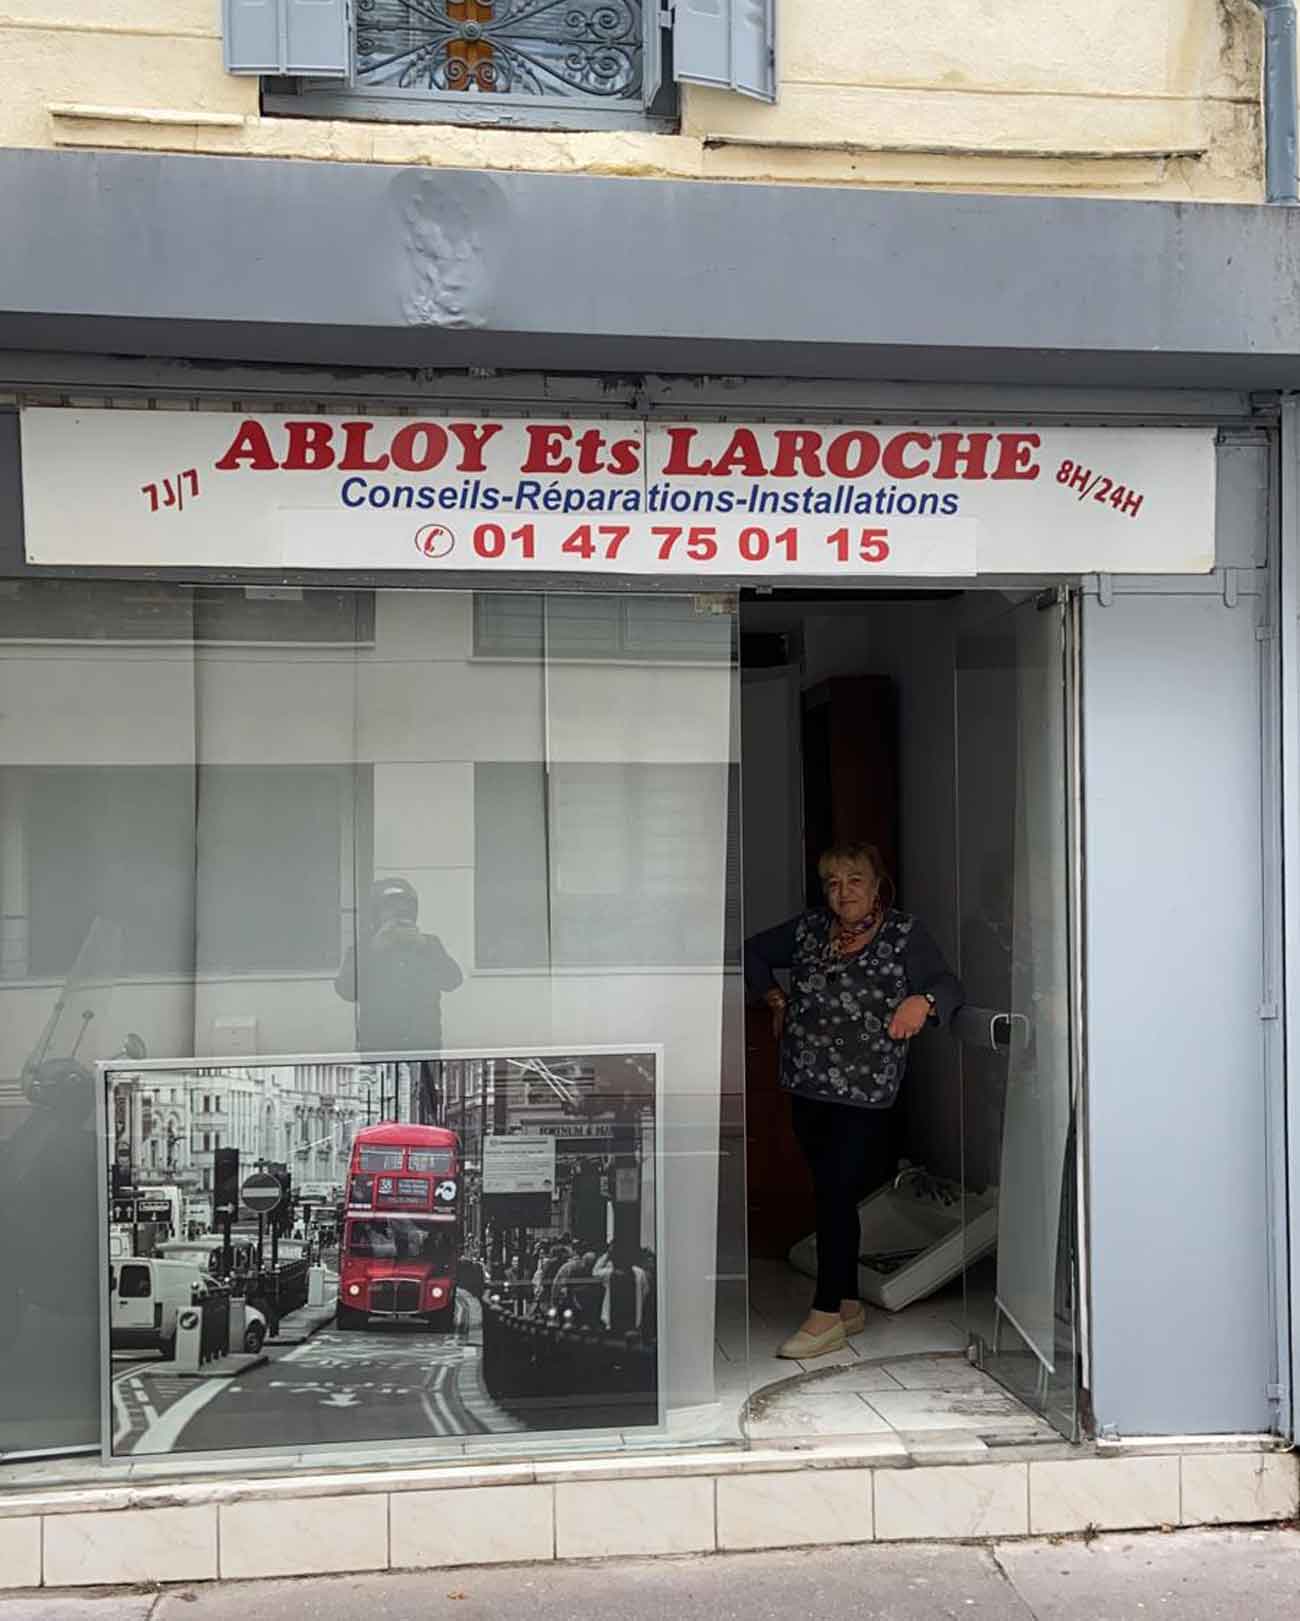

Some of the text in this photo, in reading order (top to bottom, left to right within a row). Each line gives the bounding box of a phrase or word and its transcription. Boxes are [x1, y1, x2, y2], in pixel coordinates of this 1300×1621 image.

[215, 419, 1041, 481] ABLOY Ets LAROCHE
[141, 468, 199, 512] 7J/7
[341, 476, 961, 515] Conseils-Réparations-Installations
[1056, 459, 1144, 517] 8H/24H
[473, 522, 892, 564] 01 47 75 01 15
